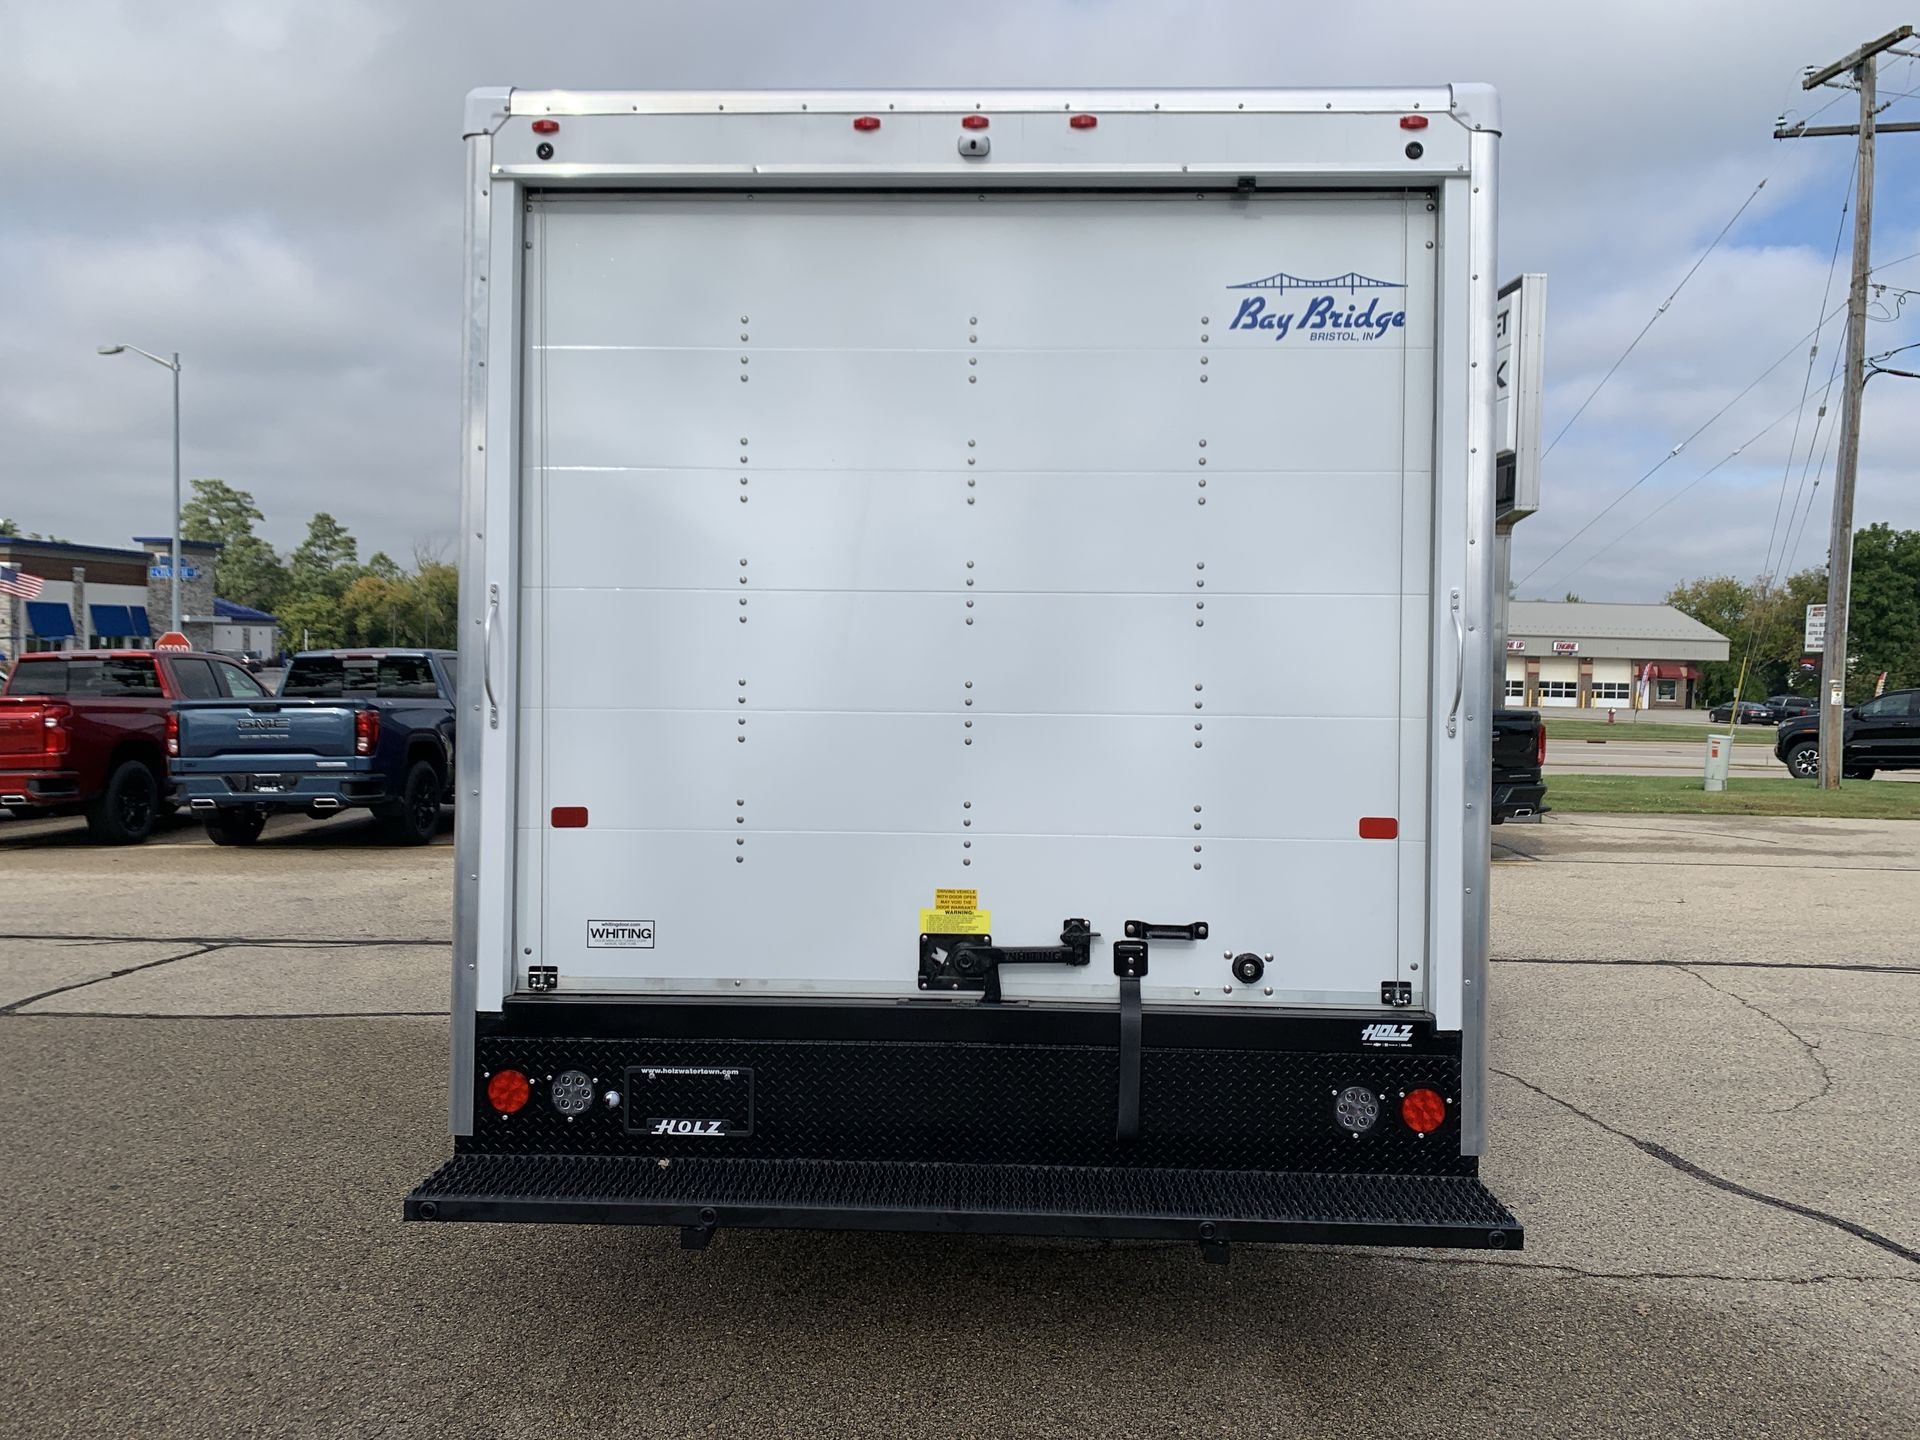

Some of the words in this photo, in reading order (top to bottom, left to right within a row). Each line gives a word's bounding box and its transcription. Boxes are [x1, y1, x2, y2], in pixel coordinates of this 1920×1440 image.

[1229, 295, 1294, 341] Bay
[1296, 295, 1406, 339] Bridge
[1309, 331, 1359, 342] BRISTOL,
[1362, 331, 1374, 341] IN
[238, 718, 290, 731] GMC
[590, 928, 652, 939] WHITING
[1361, 1024, 1413, 1041] HOLZ
[651, 1119, 725, 1136] HOLZ
